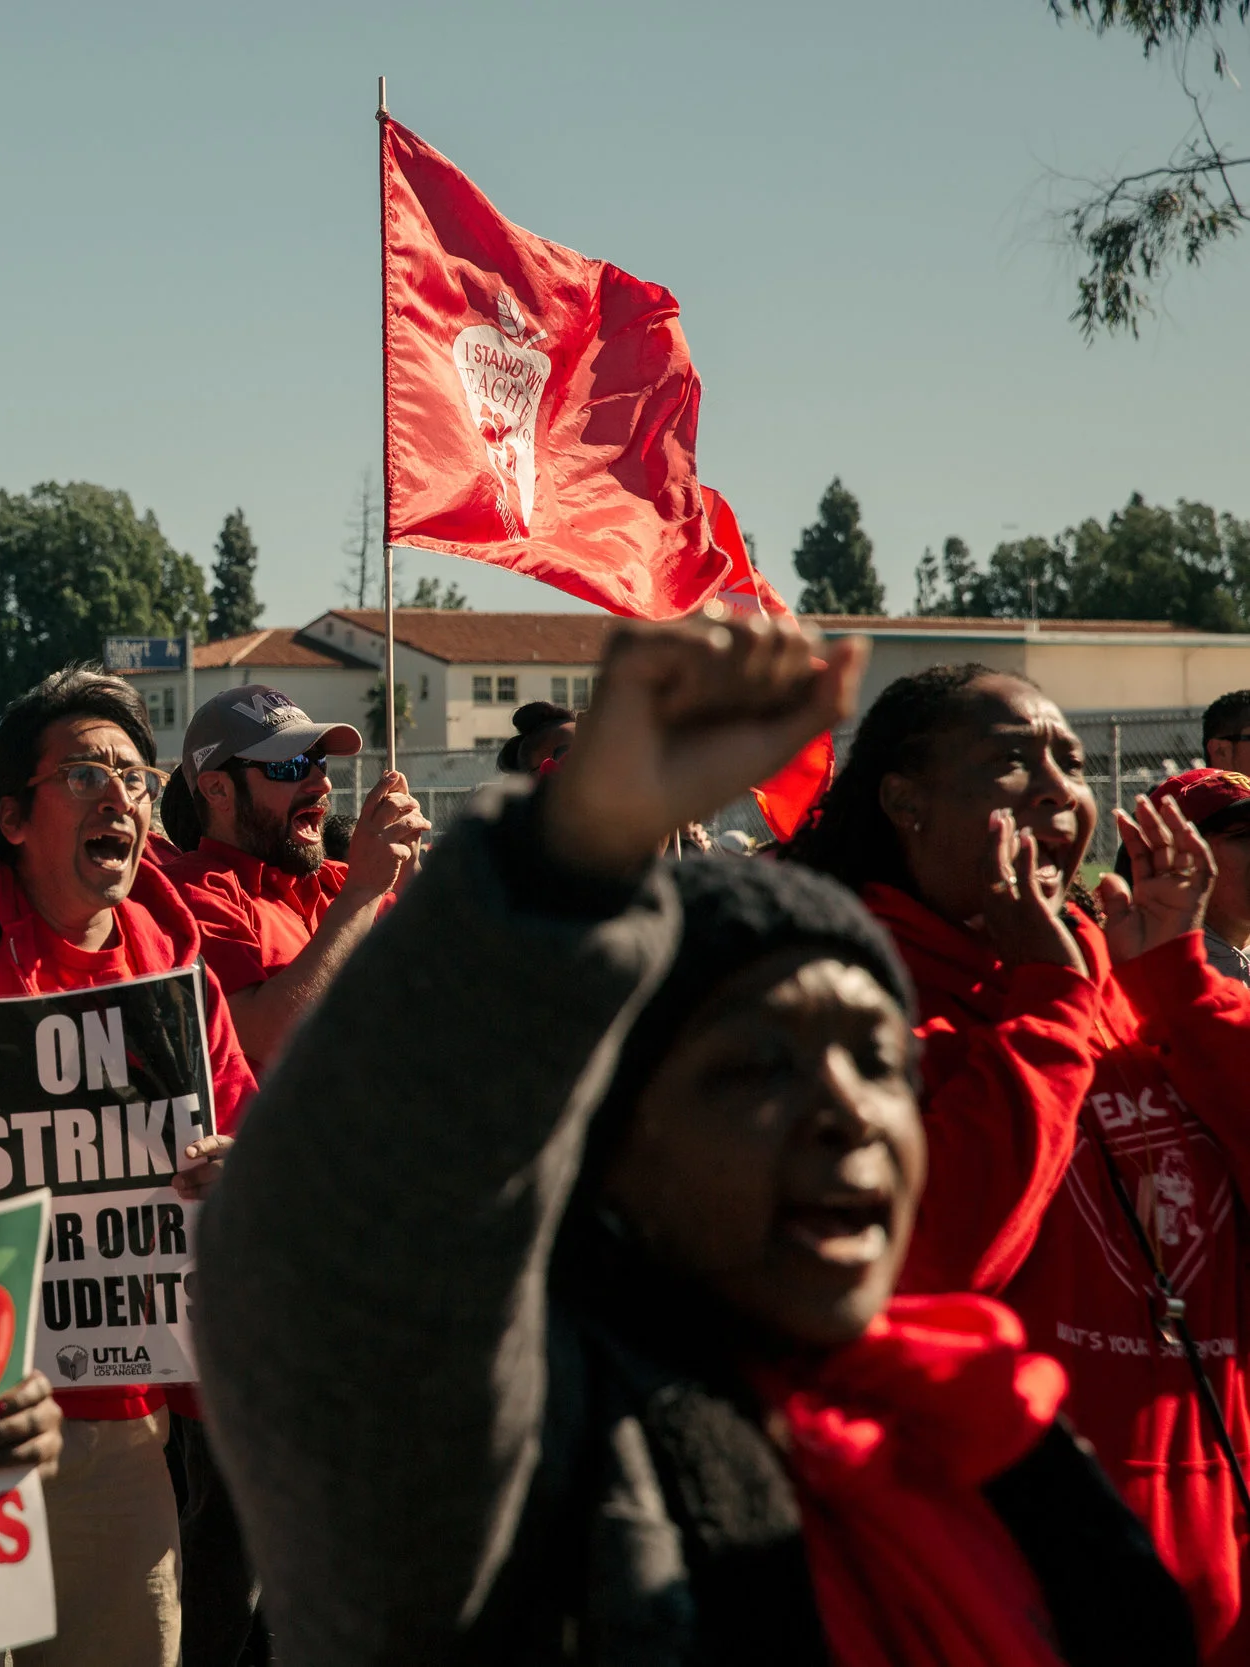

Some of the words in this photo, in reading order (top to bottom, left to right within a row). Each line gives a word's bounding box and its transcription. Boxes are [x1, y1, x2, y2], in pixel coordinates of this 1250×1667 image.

[474, 344, 524, 378] STAND
[35, 1006, 129, 1095] ON
[96, 1203, 187, 1259] OUR
[42, 1271, 198, 1331] UDENT
[92, 1346, 150, 1363] UTLA
[94, 1369, 111, 1377] LOS
[113, 1368, 152, 1376] ANGELES
